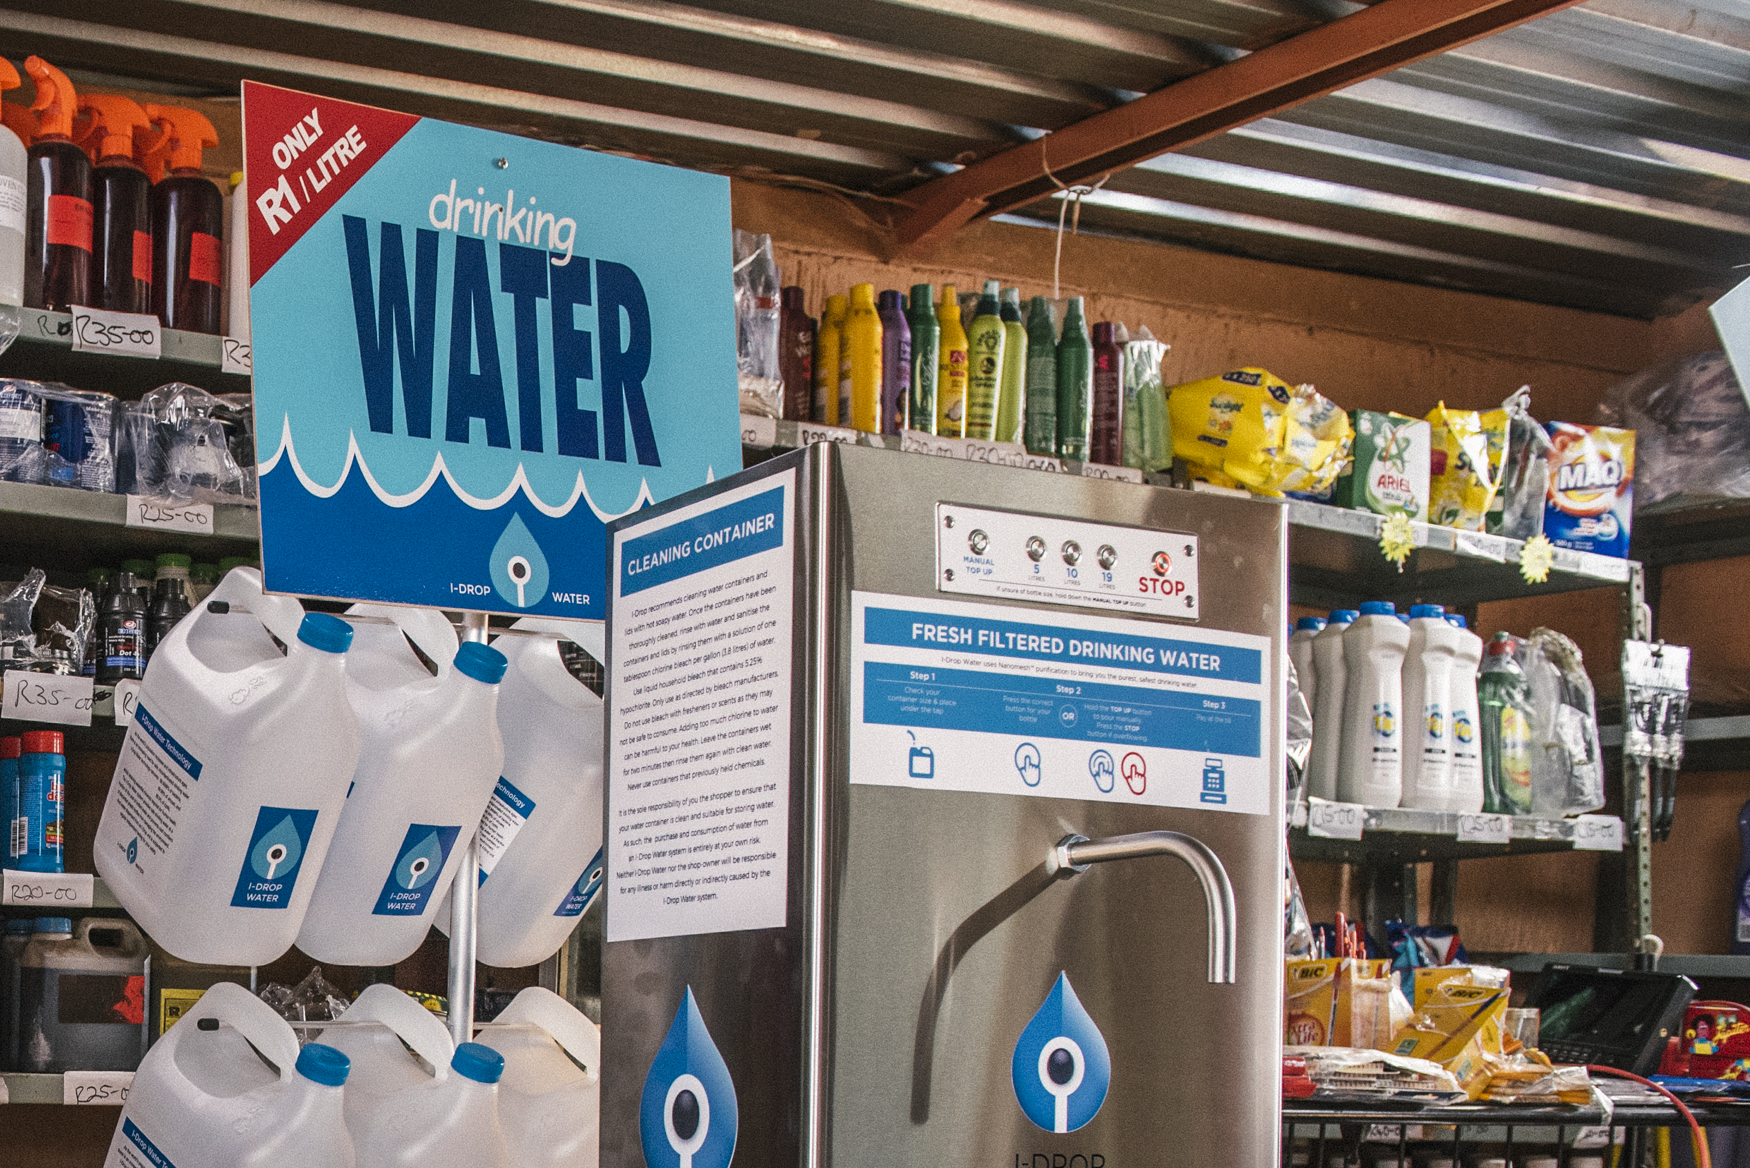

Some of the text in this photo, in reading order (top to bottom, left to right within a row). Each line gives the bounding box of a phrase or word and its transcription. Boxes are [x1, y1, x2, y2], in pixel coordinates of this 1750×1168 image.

[272, 107, 326, 170] ONLY
[256, 173, 297, 235] R1
[310, 125, 367, 193] LITRE
[428, 179, 577, 266] drinking
[342, 214, 662, 468] WATER
[1558, 461, 1623, 491] MAQ
[1377, 475, 1411, 493] ARIEL
[627, 511, 774, 576] CLEANING CONTAINER
[963, 556, 994, 566] MANUAL
[966, 566, 980, 574] TOP
[1033, 564, 1039, 574] 5
[1066, 567, 1077, 578] 10
[1102, 572, 1112, 582] 19
[450, 583, 491, 597] I-DROP
[1139, 576, 1185, 597] STOP
[551, 591, 591, 606] WATER
[912, 623, 1220, 671] FRESH FILTERED DRINKING WATER
[910, 671, 929, 682] Step
[941, 656, 961, 665] I-Drop
[963, 658, 982, 666] Water
[1035, 665, 1069, 676] purification
[1078, 669, 1094, 679] bring
[1095, 672, 1105, 680] you
[1107, 672, 1117, 680] the
[1139, 676, 1156, 684] safest
[1157, 677, 1179, 687] drinking
[1056, 685, 1074, 695] Step
[1202, 700, 1225, 709] Step 3
[1062, 712, 1074, 721] OR
[1124, 724, 1139, 732] STOP
[139, 714, 193, 770] I-Drop Water Technology
[249, 883, 282, 894] I-DROP
[246, 893, 279, 903] WATER
[389, 892, 421, 902] I-DROP
[663, 892, 717, 906] I-Drop Water system.
[387, 902, 416, 911] WATER
[1299, 966, 1325, 978] BIC
[1452, 988, 1482, 999] BIC
[130, 1130, 148, 1151] I-Drop
[145, 1146, 163, 1165] Water
